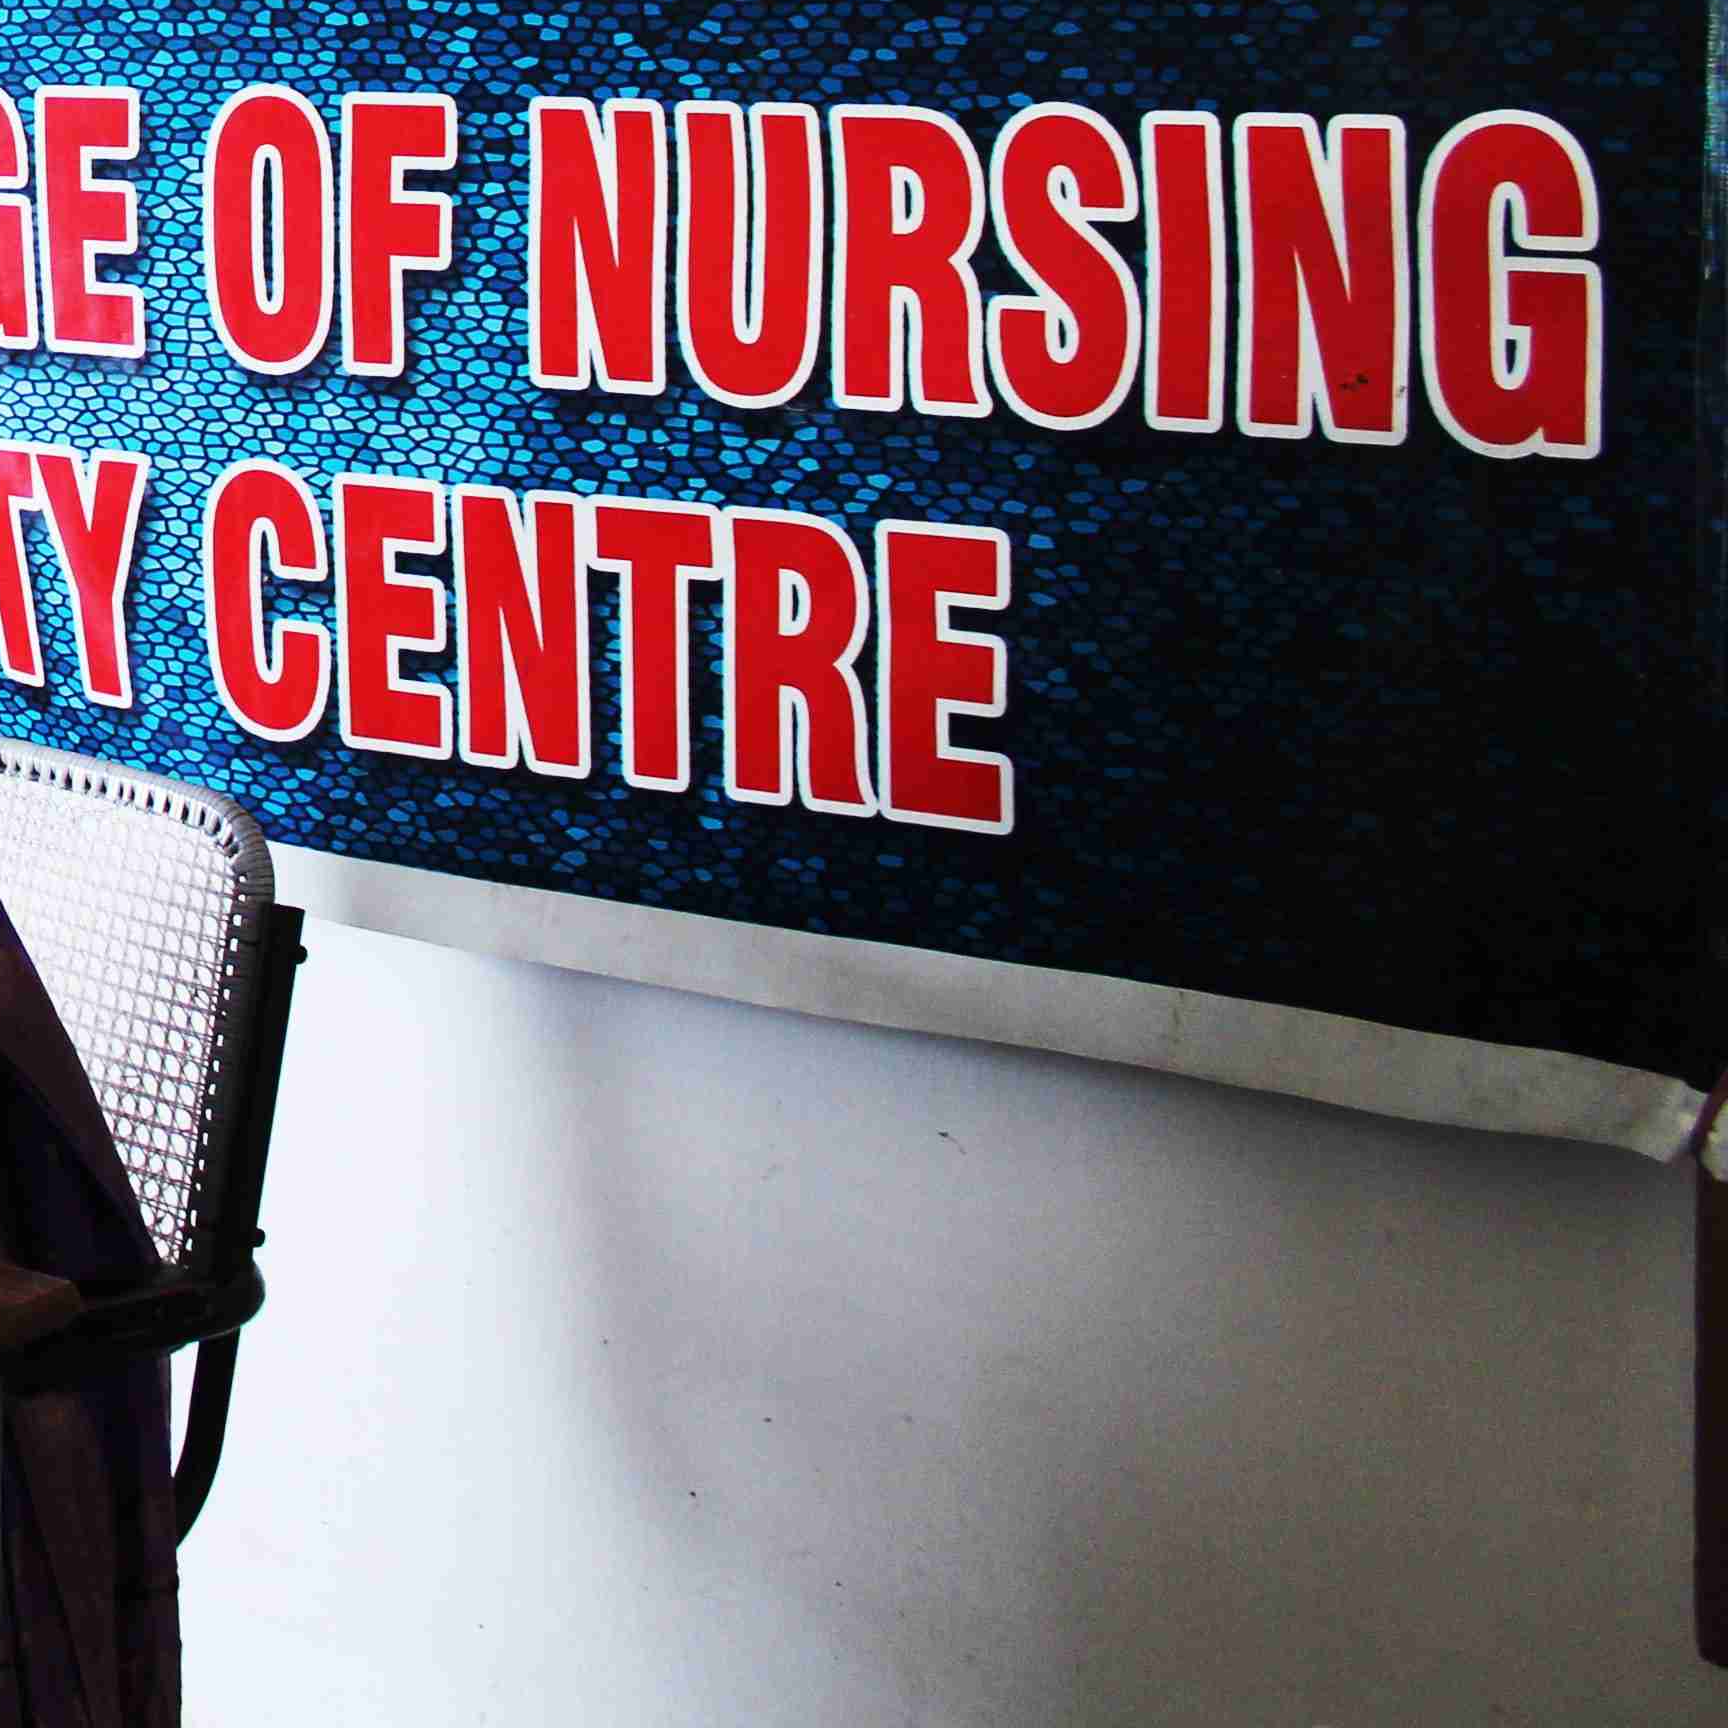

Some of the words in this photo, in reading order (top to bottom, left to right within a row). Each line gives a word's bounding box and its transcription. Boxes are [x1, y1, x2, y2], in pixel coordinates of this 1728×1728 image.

[203, 82, 458, 377] OF
[529, 95, 1602, 460] NURSING
[203, 456, 1014, 836] CENTRE
